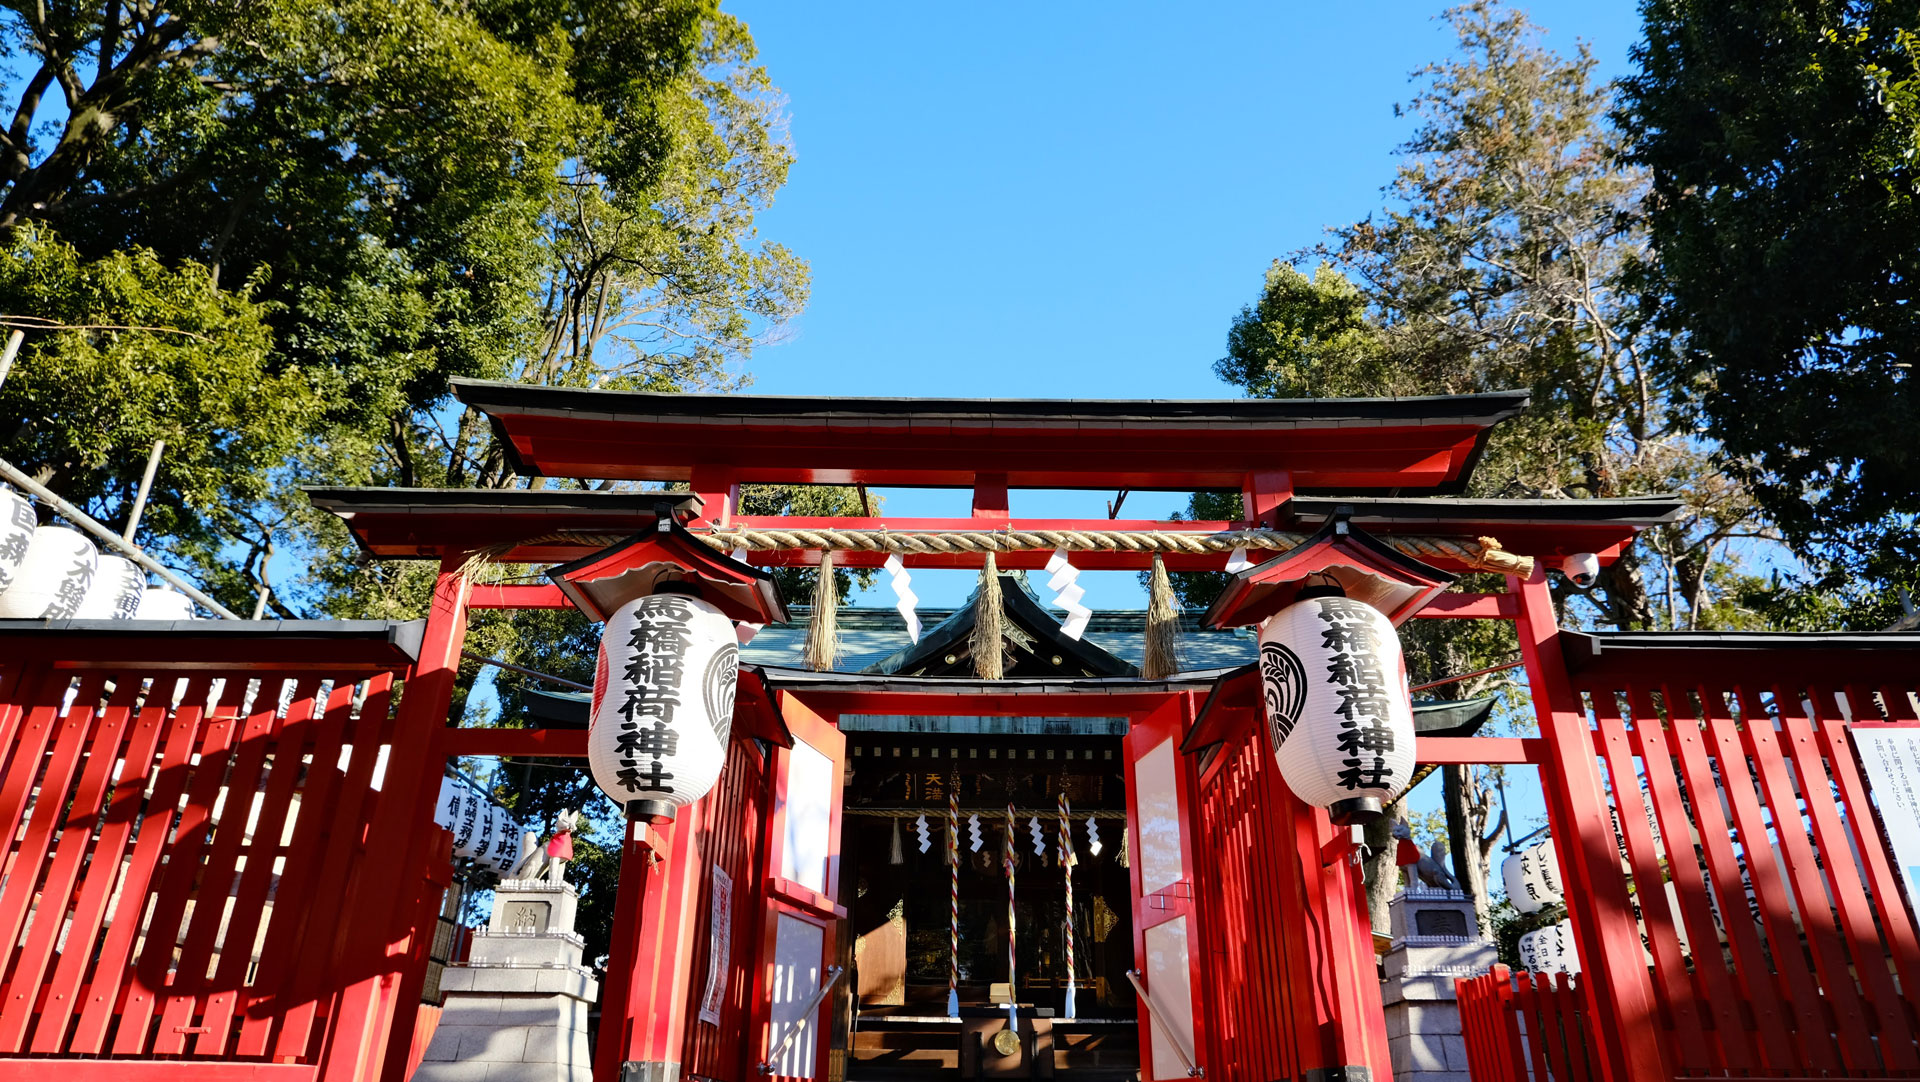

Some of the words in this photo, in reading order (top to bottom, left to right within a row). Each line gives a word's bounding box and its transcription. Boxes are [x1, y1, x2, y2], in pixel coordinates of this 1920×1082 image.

[614, 595, 694, 794] 馬橋稲荷神社
[1314, 598, 1395, 791] 馬橋稲荷神社
